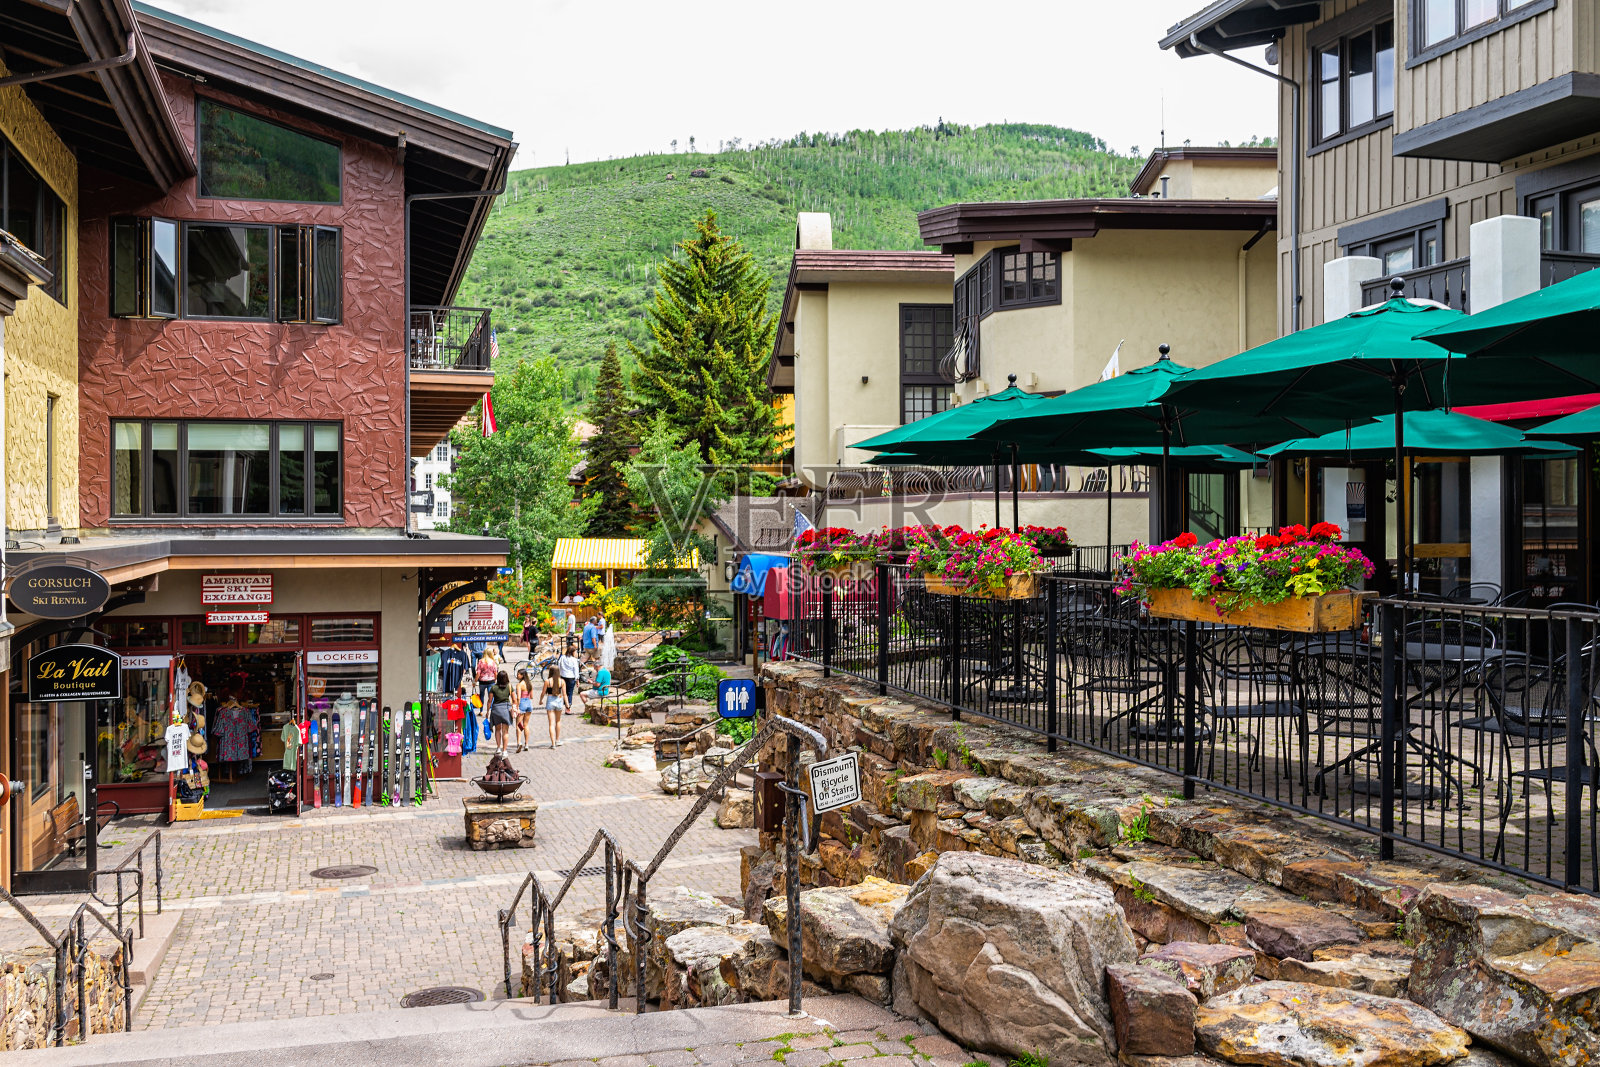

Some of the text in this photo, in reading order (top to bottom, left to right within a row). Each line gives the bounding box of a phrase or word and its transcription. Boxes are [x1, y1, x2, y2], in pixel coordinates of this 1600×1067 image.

[28, 577, 92, 588] GORSUCH
[122, 658, 149, 667] SKIS
[316, 653, 369, 662] LOCKERS
[37, 657, 113, 681] La Vail
[53, 681, 96, 691] Boutique
[814, 761, 853, 778] Dismount
[821, 774, 849, 788] Bicycle
[818, 791, 830, 801] On
[831, 785, 854, 797] Stairs
